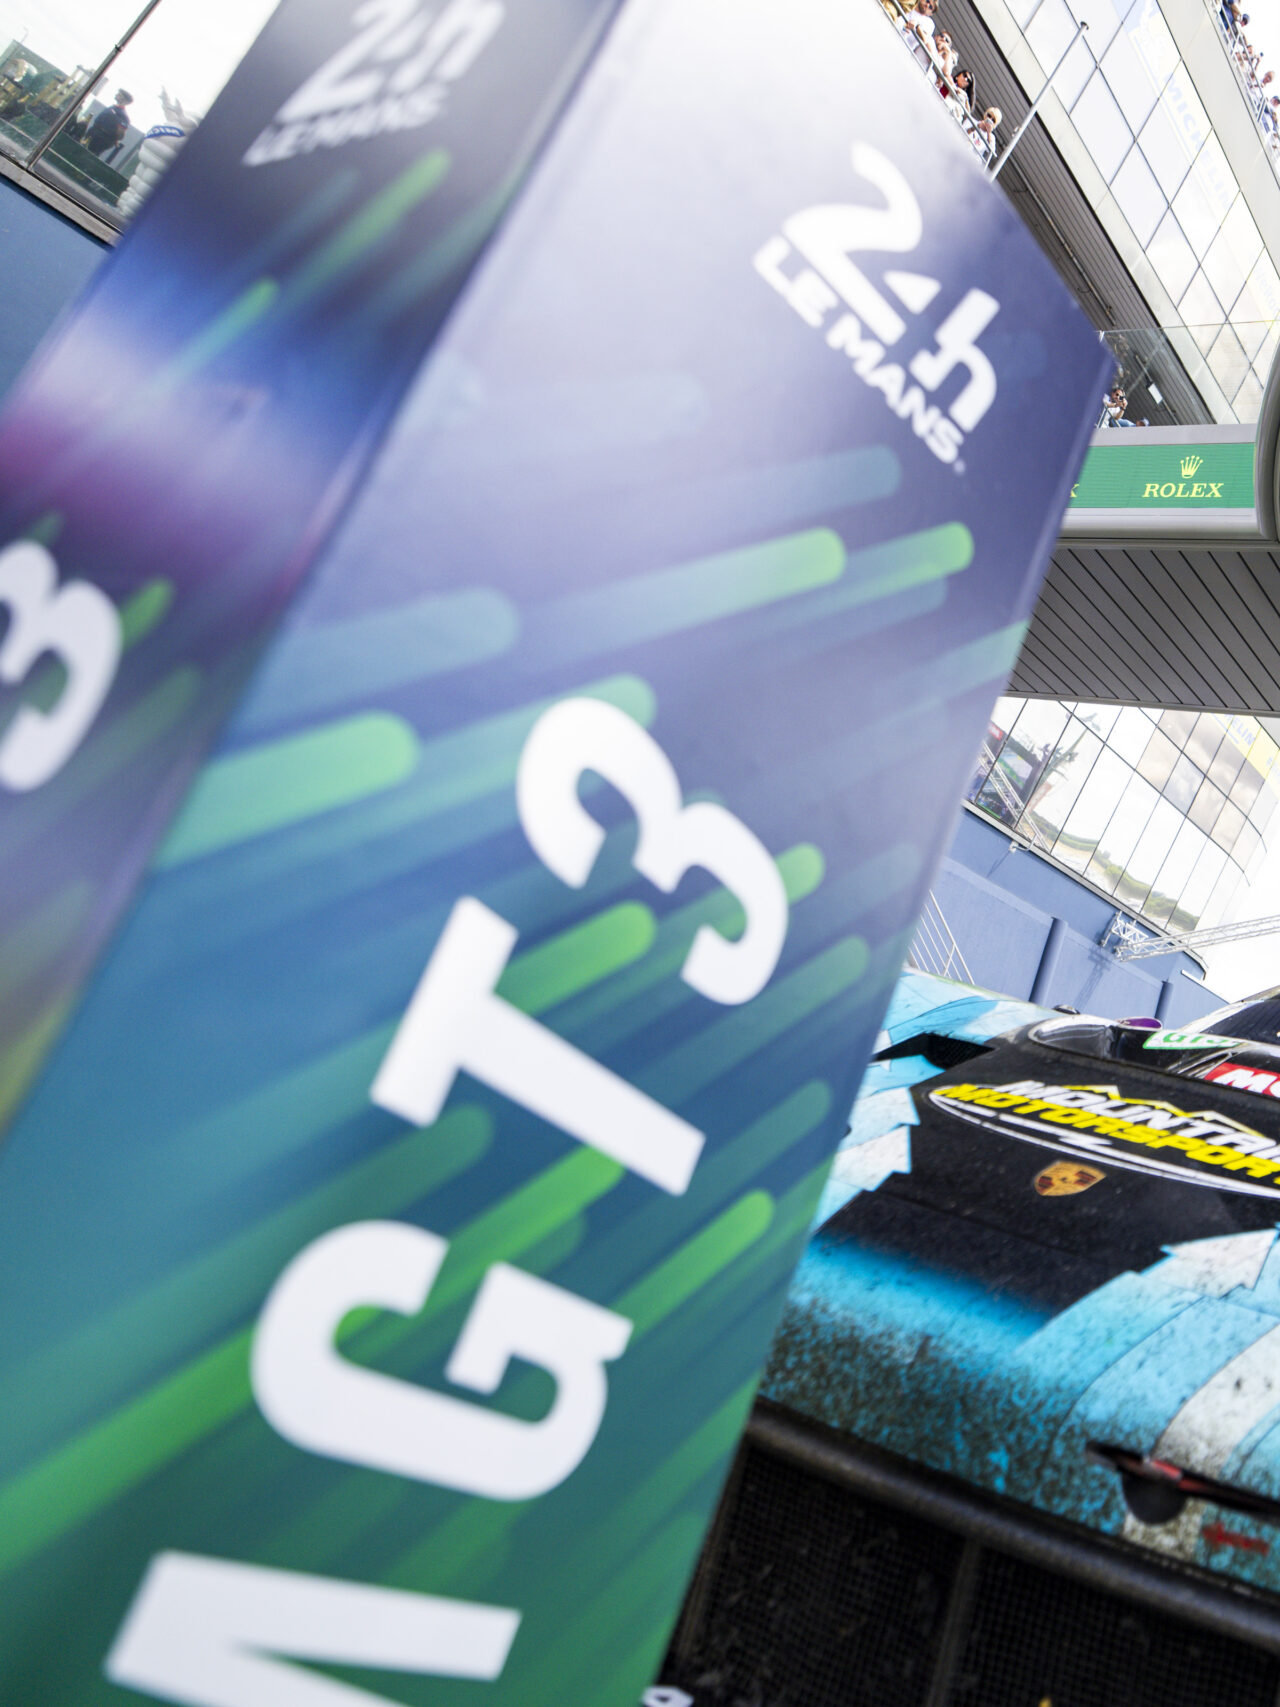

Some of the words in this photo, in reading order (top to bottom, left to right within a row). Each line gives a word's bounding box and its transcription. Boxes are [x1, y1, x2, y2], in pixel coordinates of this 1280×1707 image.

[752, 234, 839, 329] LE
[826, 313, 966, 464] MANS
[781, 140, 1001, 433] 24h
[1141, 482, 1225, 498] ROLEX
